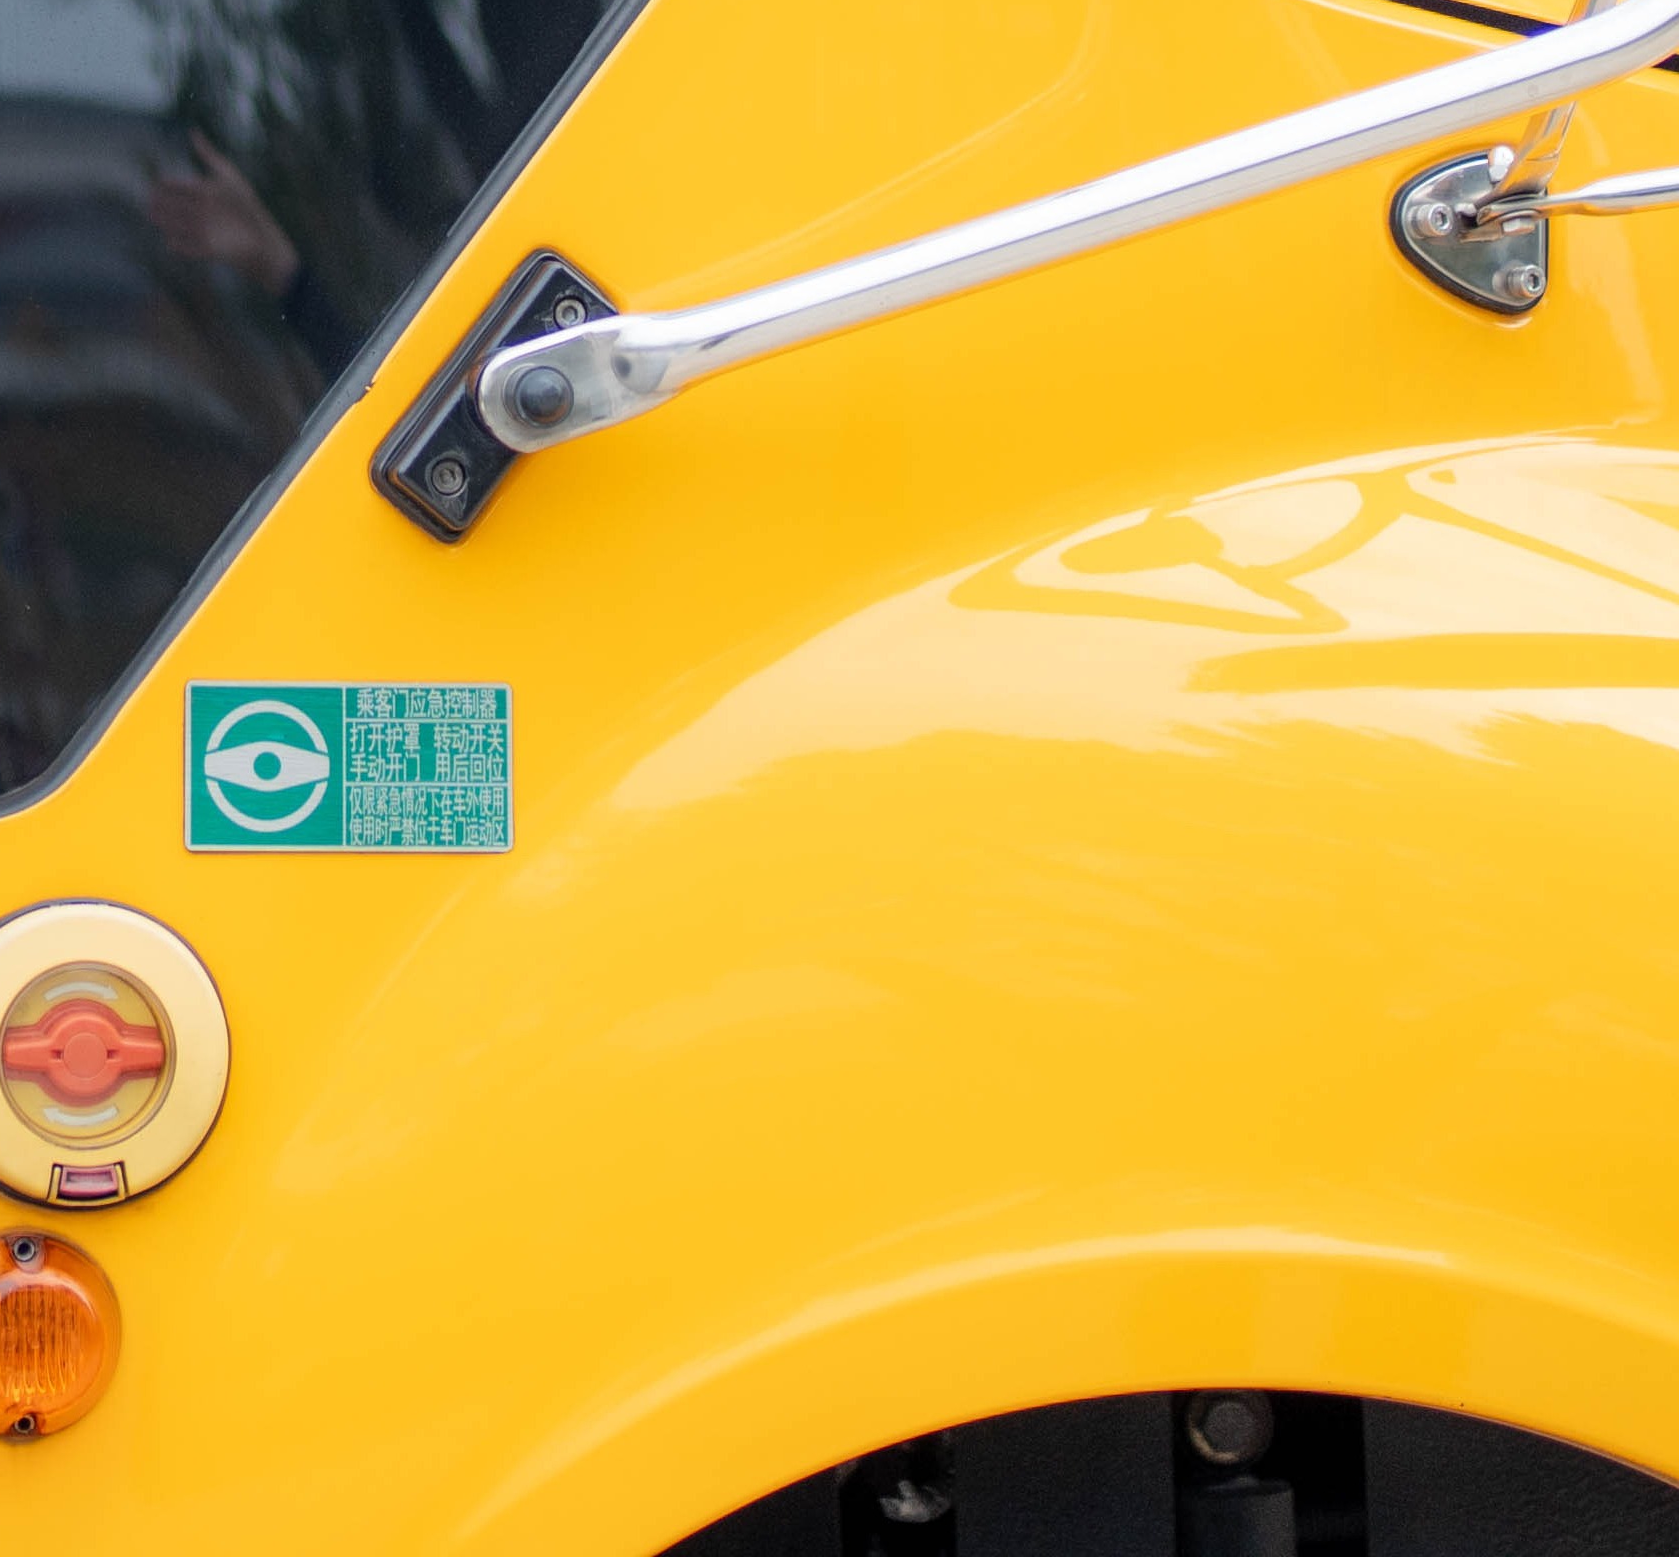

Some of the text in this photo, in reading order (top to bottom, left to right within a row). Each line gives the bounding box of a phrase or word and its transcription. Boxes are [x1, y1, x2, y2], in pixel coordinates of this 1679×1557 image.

[356, 688, 497, 719] 乘客门应急控制器
[350, 724, 504, 753] 打开护罩 转动开关
[350, 753, 505, 782] 手动开门 用后回位
[349, 787, 504, 815] 仅限紧急情况下在车外使用
[349, 815, 505, 846] 使用时严禁位于车门运动区
